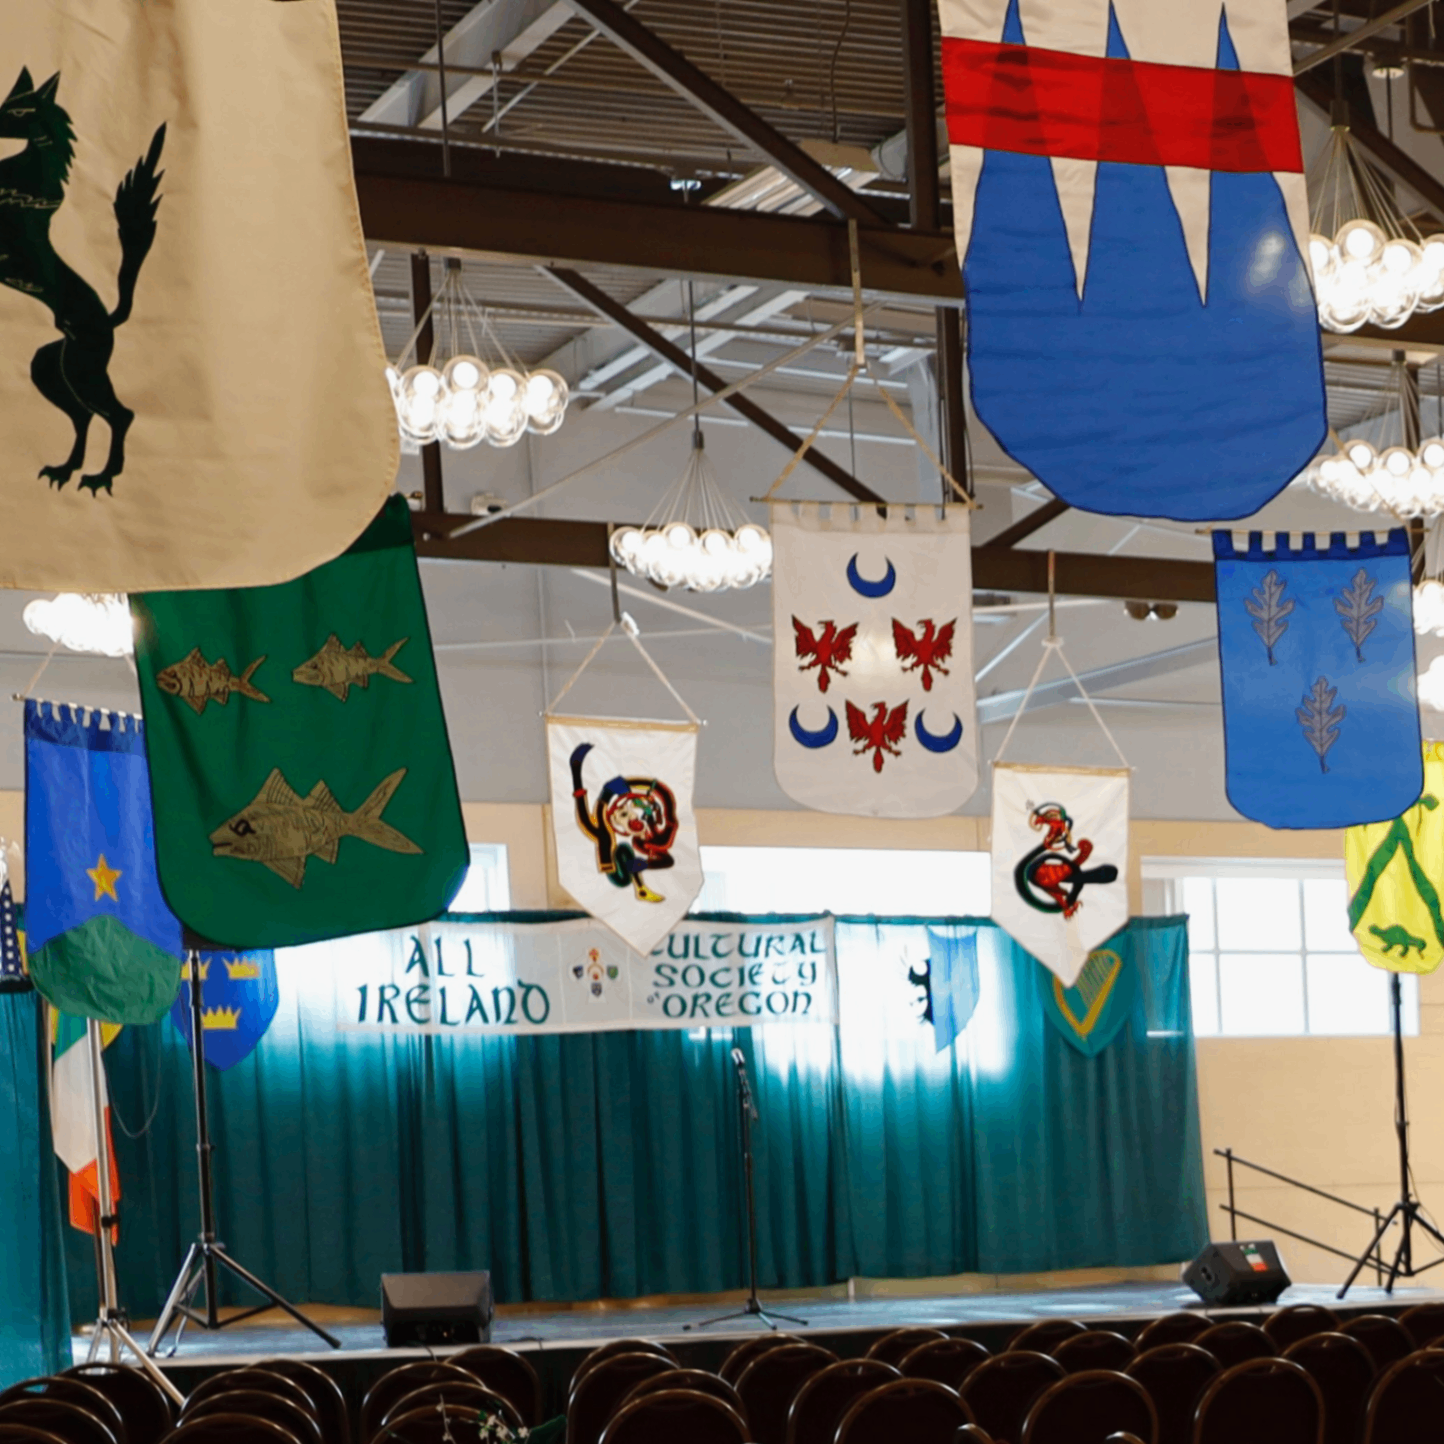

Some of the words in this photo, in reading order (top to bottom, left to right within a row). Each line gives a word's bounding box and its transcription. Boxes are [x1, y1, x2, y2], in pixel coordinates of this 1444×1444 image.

[405, 934, 485, 978] ALL
[653, 961, 817, 988] SOCIETY
[356, 978, 550, 1026] IRELAND
